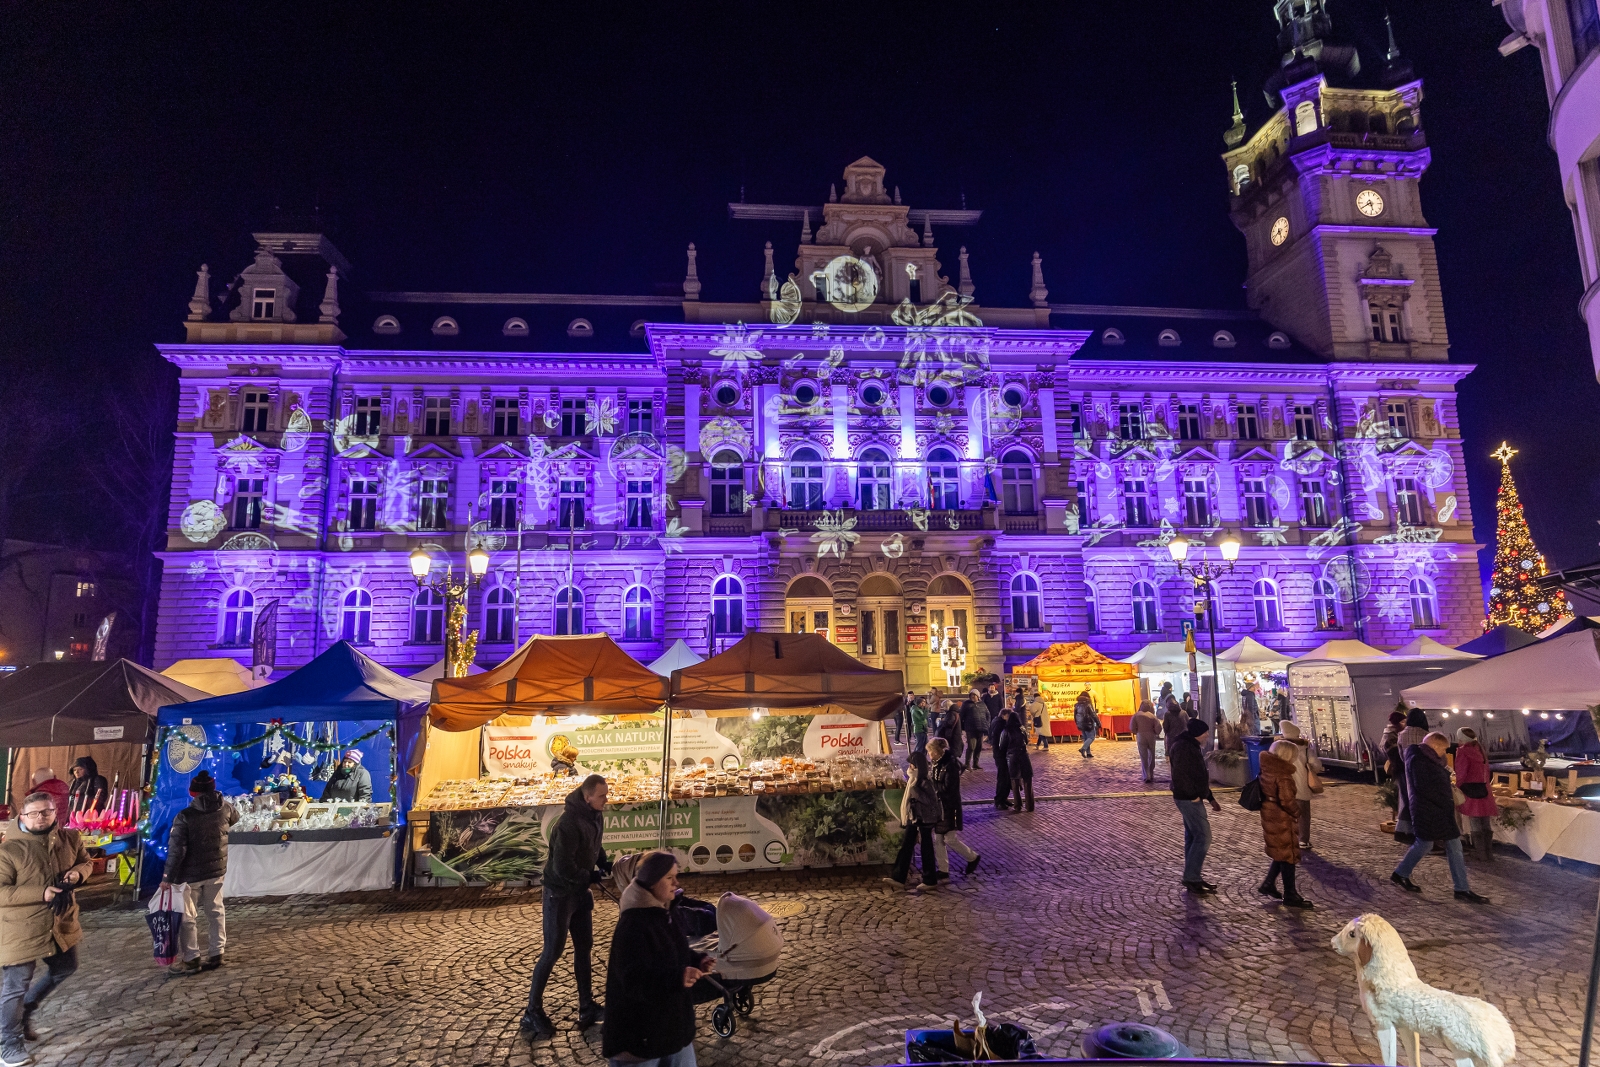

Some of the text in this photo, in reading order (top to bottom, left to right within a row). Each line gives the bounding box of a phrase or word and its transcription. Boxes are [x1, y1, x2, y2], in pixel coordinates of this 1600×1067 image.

[576, 730, 663, 745] SMAK NATURY
[821, 732, 864, 748] Polska
[488, 744, 532, 760] Polska
[502, 758, 538, 771] smakuje
